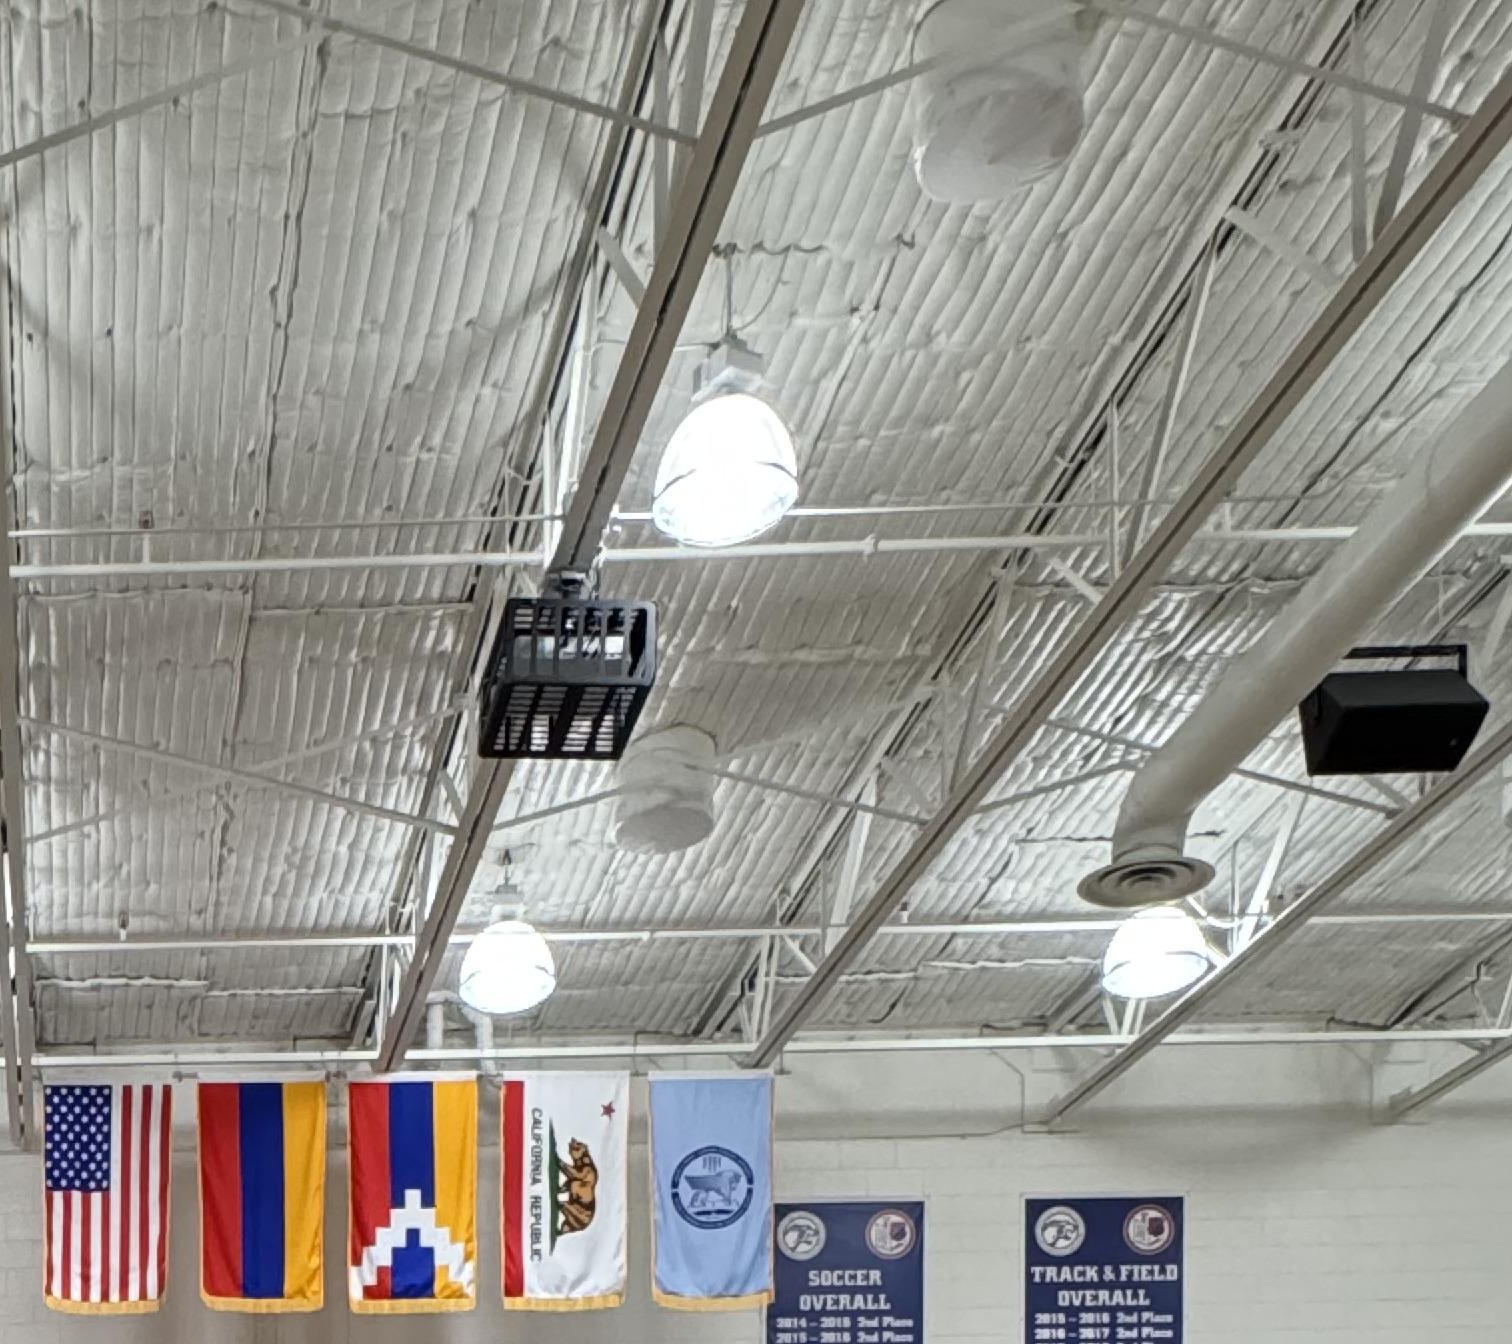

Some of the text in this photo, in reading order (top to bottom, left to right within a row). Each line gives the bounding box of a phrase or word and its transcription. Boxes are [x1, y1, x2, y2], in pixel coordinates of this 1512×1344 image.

[530, 1107, 543, 1263] CALIFORNIA REPUBLIC
[809, 1270, 881, 1285] SOCCER
[1031, 1265, 1177, 1282] TRACK & FIELD
[800, 1295, 891, 1310] OVERALL
[1058, 1290, 1149, 1306] OVERALL
